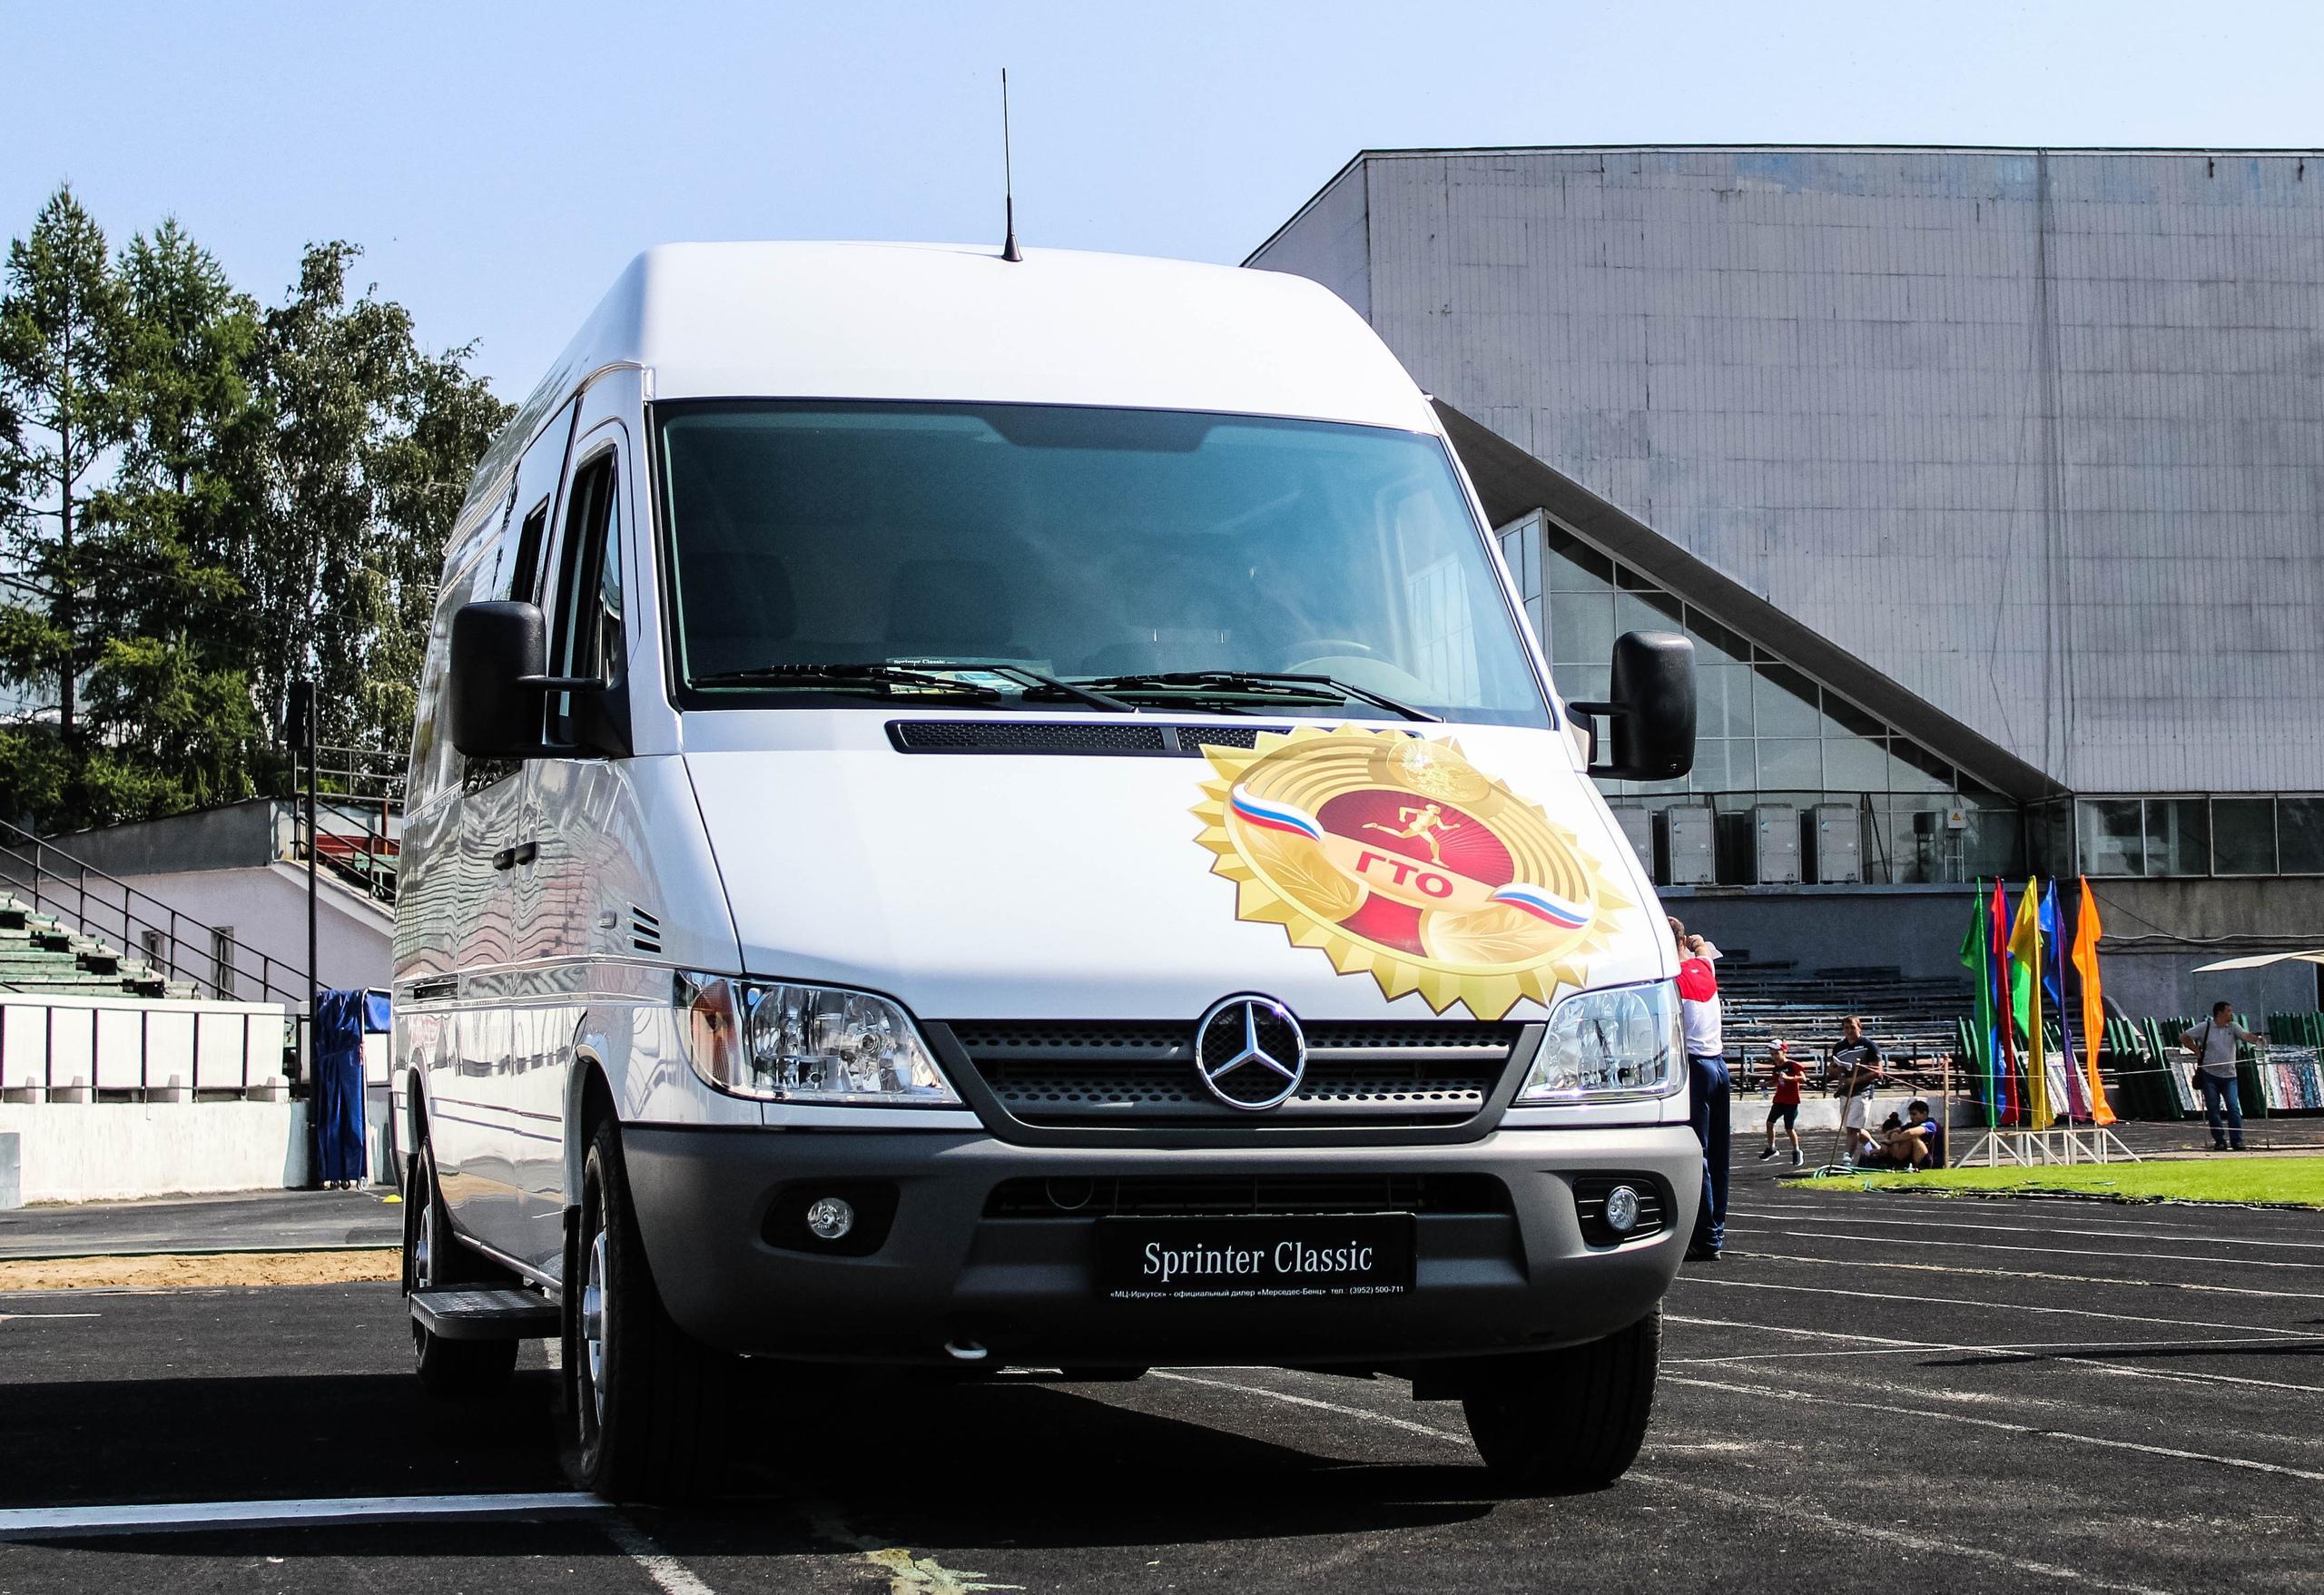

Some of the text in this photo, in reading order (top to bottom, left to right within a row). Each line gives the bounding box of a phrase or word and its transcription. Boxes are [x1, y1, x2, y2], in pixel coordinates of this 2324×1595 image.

[1355, 851, 1453, 898] ГТО
[1143, 1240, 1373, 1283] Sprinter Classic
[1173, 1289, 1230, 1299] официальный
[1230, 1289, 1256, 1298] дилер
[1349, 1285, 1374, 1295] (3952)
[1374, 1285, 1404, 1294] 500-711
